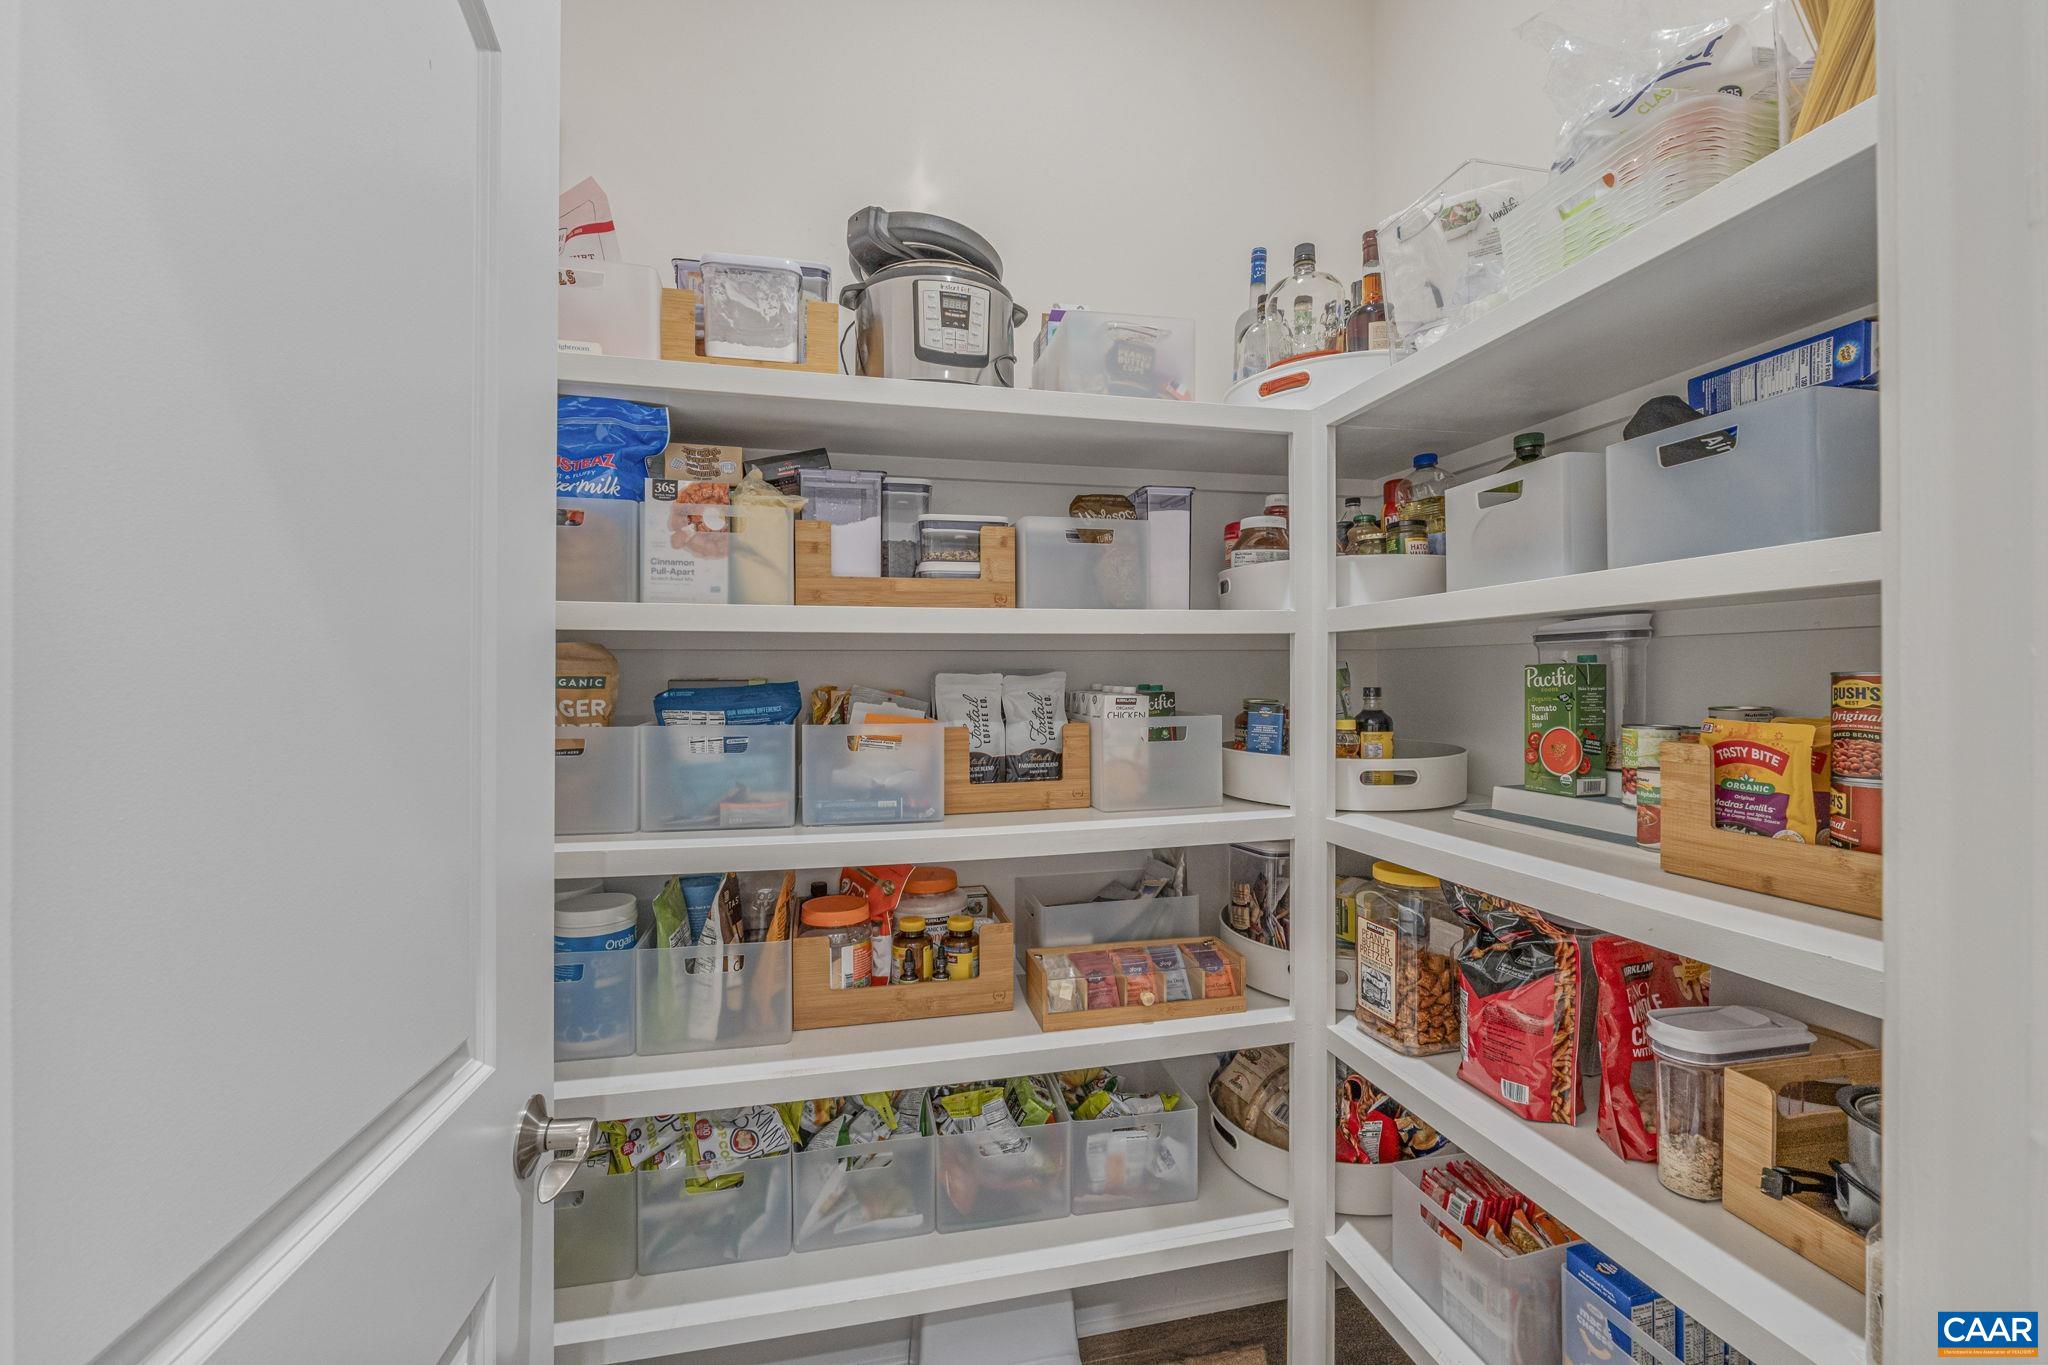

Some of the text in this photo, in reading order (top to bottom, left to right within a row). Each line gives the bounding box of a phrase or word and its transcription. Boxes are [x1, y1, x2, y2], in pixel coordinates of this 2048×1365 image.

[655, 482, 676, 494] 365
[650, 557, 694, 567] Cinnamon
[651, 567, 694, 577] Pull-Apart
[1524, 667, 1576, 687] Pacific
[1834, 687, 1881, 701] BUSH'S
[559, 699, 606, 717] GER
[1046, 710, 1056, 740] COFFEE
[1716, 747, 1780, 767] TASTY BITE
[1726, 781, 1769, 793] ORGANIC
[605, 933, 634, 949] Orgain
[1361, 928, 1390, 948] PEANUT
[1360, 945, 1393, 966] PRETZELS
[1361, 938, 1390, 957] BUTTER
[744, 1106, 788, 1153] SKINNY
